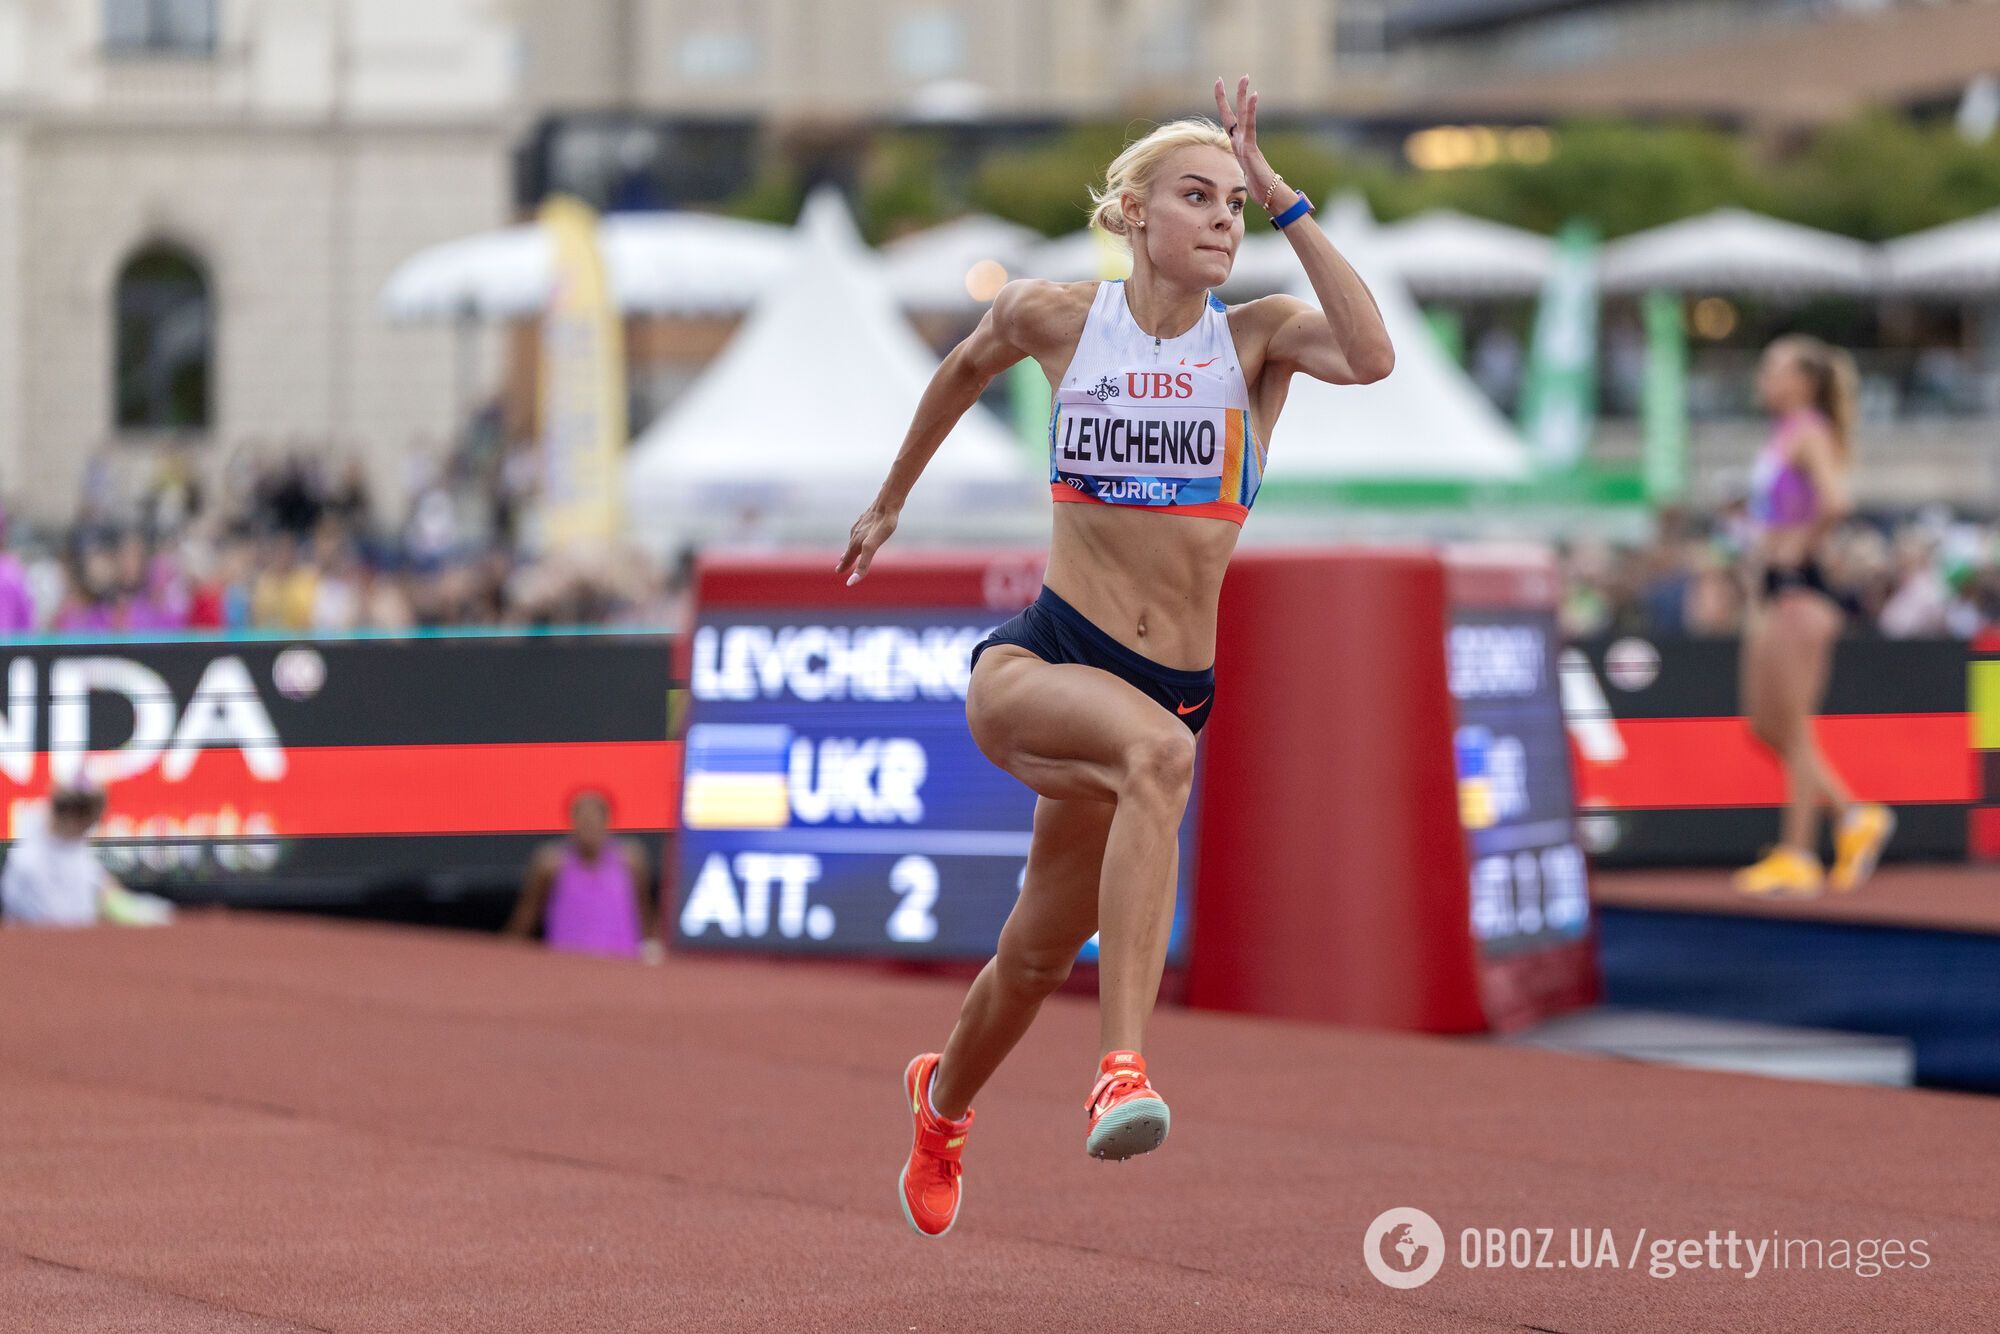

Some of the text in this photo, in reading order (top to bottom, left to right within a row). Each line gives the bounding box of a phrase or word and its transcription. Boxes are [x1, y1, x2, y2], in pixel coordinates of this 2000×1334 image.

[1125, 372, 1193, 399] UBS
[1063, 417, 1216, 466] LEVCHENKO
[1097, 480, 1178, 500] ZURICH
[790, 736, 928, 824] UKR
[680, 852, 940, 943] ATT. 2
